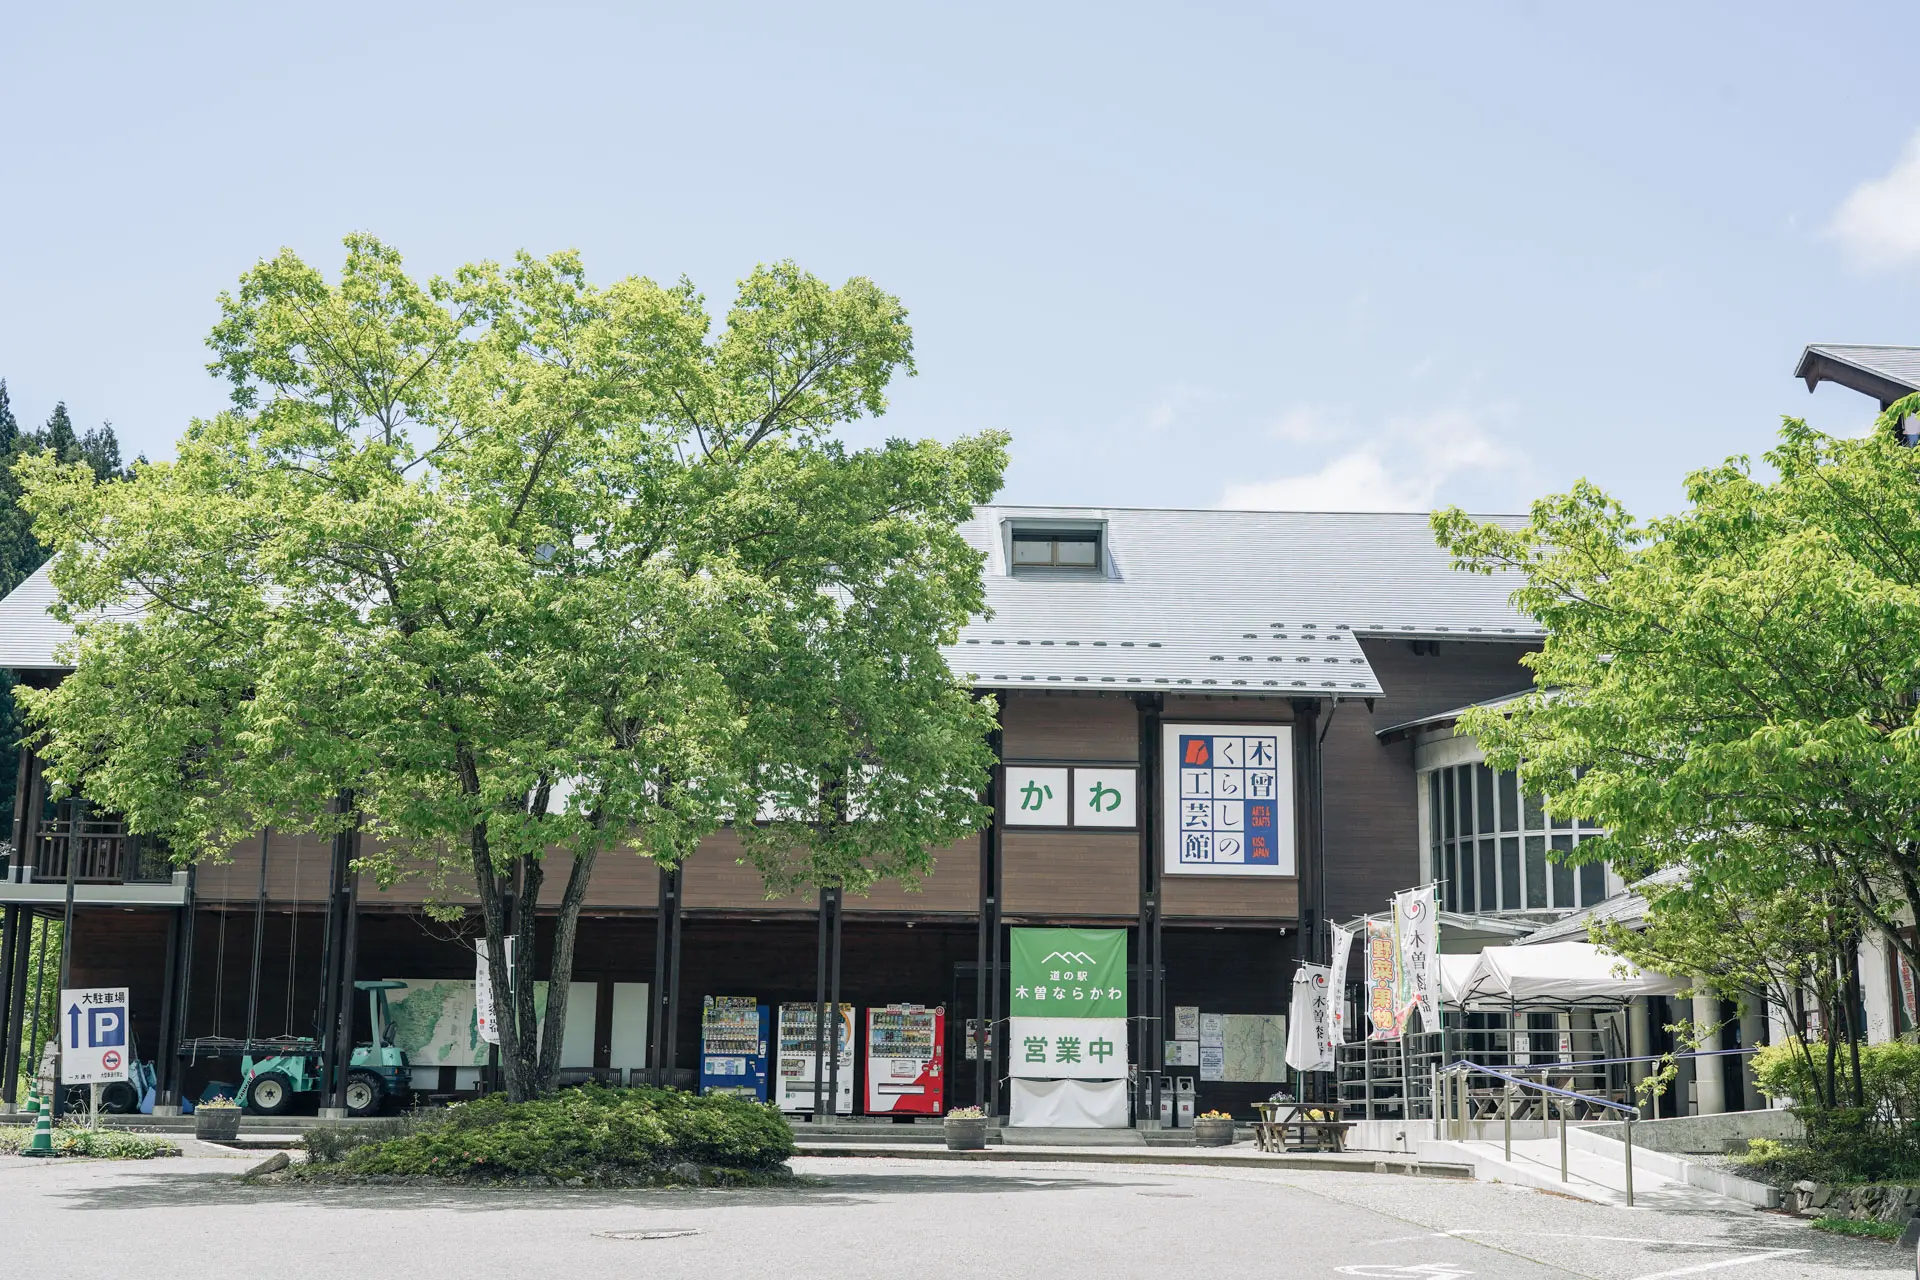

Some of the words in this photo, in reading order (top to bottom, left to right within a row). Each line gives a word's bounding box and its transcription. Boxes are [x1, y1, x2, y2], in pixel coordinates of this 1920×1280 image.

[1020, 780, 1122, 813] かわ
[1219, 741, 1241, 857] くらしの
[1185, 771, 1210, 860] 工芸館
[1252, 806, 1264, 816] ARTS
[1252, 817, 1271, 827] CRAFTS
[1252, 848, 1270, 858] JAPAN
[1049, 970, 1088, 982] 道の駅
[1371, 938, 1394, 1029] 野菜・果物
[82, 992, 125, 1004] 大駐車場
[1015, 985, 1122, 1001] 木曽ならかわ
[95, 1012, 119, 1043] P
[1023, 1036, 1114, 1064] 営業中
[238, 1076, 253, 1100] YANMAR
